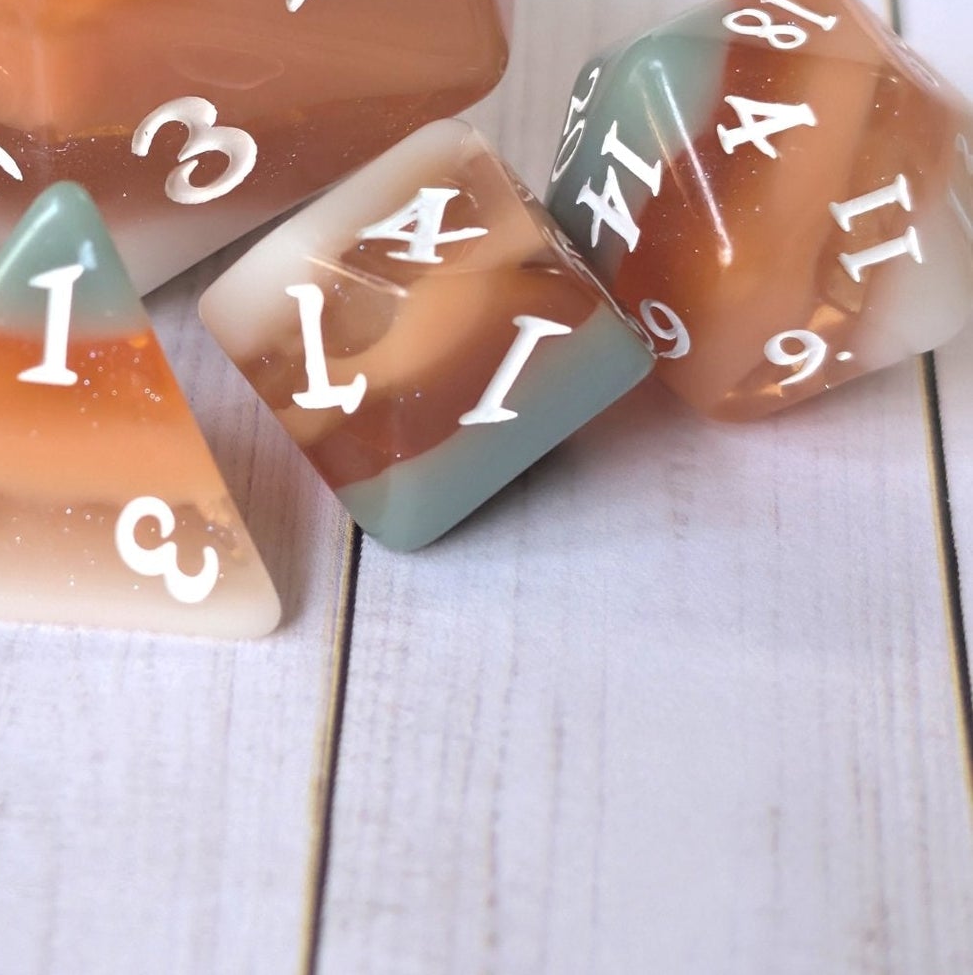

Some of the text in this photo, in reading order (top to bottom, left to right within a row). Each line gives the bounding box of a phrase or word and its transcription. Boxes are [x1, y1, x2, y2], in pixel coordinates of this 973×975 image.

[131, 95, 257, 204] 3
[716, 95, 818, 159] 4
[356, 187, 489, 264] 4
[576, 120, 662, 253] 14
[828, 173, 923, 283] 11
[17, 264, 84, 387] 1
[114, 495, 220, 604] 3
